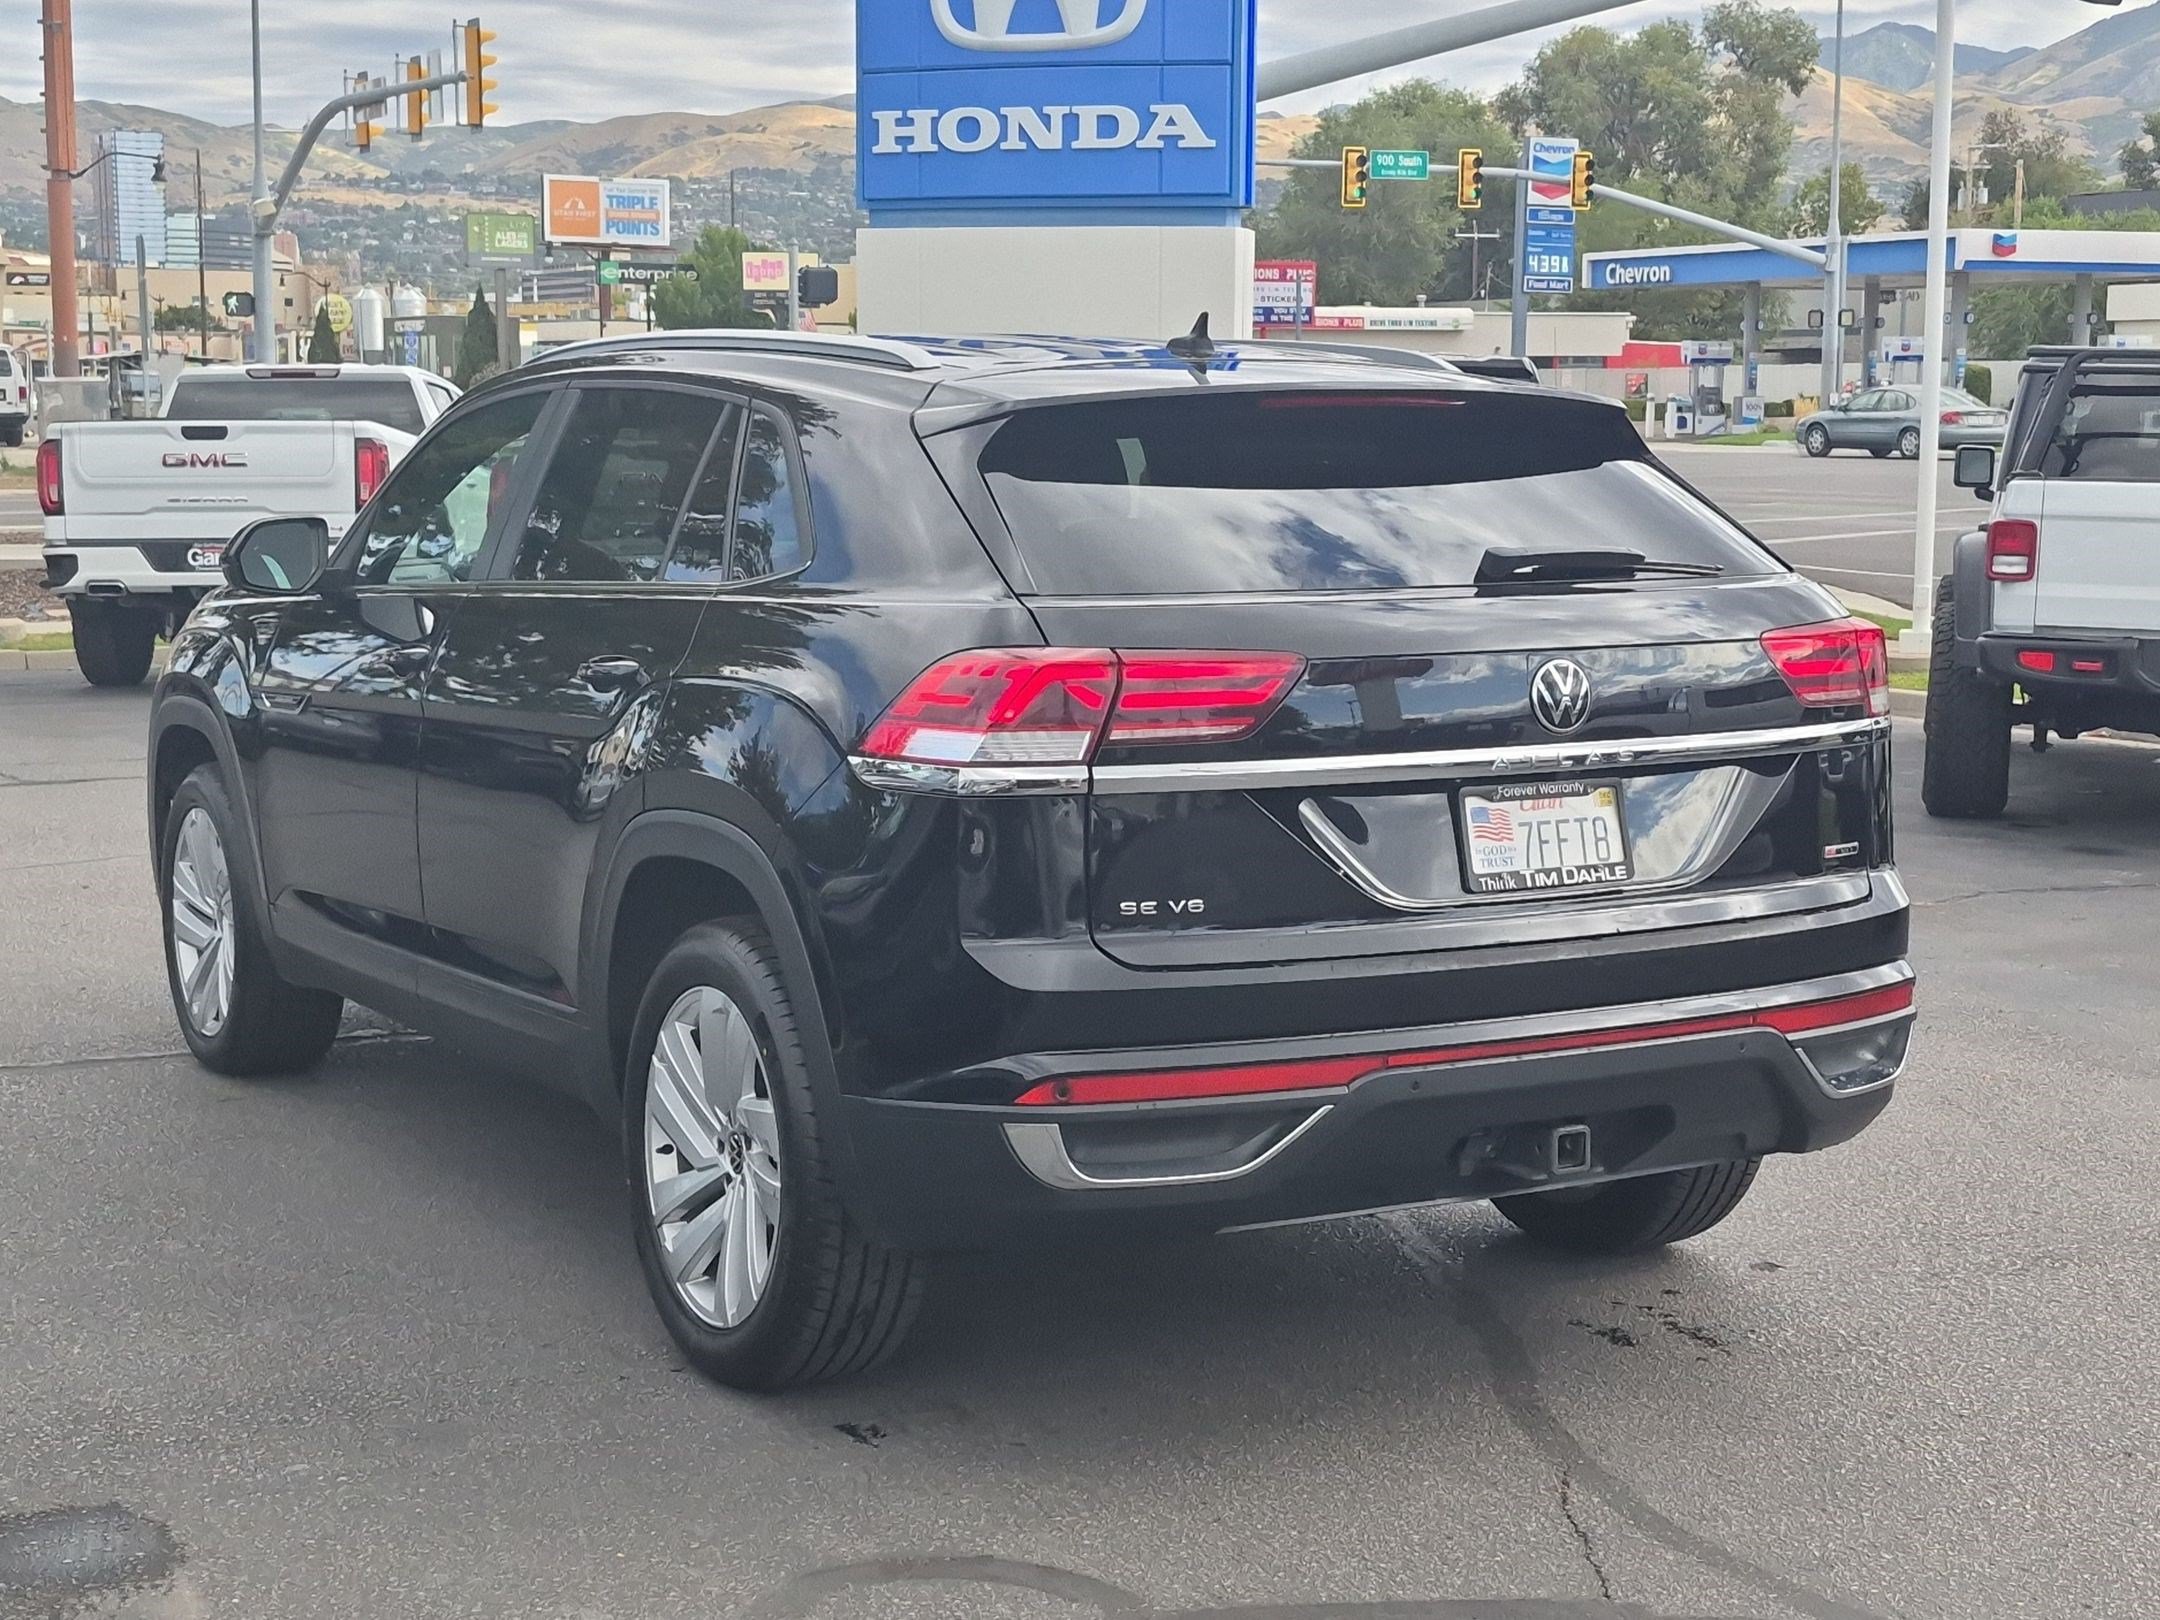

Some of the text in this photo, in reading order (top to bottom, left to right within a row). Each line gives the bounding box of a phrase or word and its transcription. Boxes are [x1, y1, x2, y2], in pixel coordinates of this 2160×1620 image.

[871, 104, 1216, 154] HONDA
[1533, 142, 1575, 154] Chevron
[1376, 154, 1423, 167] 900 South
[606, 195, 658, 210] TRIPLE
[605, 221, 660, 236] POINTS
[1605, 262, 1671, 285] Chevron
[1549, 280, 1569, 290] Mart
[1343, 318, 1363, 327] PLUS
[162, 453, 248, 468] GMC
[186, 548, 222, 566] Gar
[1491, 747, 1636, 771] ATLAS
[1498, 781, 1585, 798] Forever Warranty
[1518, 815, 1611, 869] 7FFT8
[1482, 844, 1507, 858] GOD
[1479, 856, 1516, 869] TRUST
[1519, 868, 1559, 888] TIM
[1561, 864, 1628, 885] DAHLE
[1119, 898, 1205, 915] SE V6
